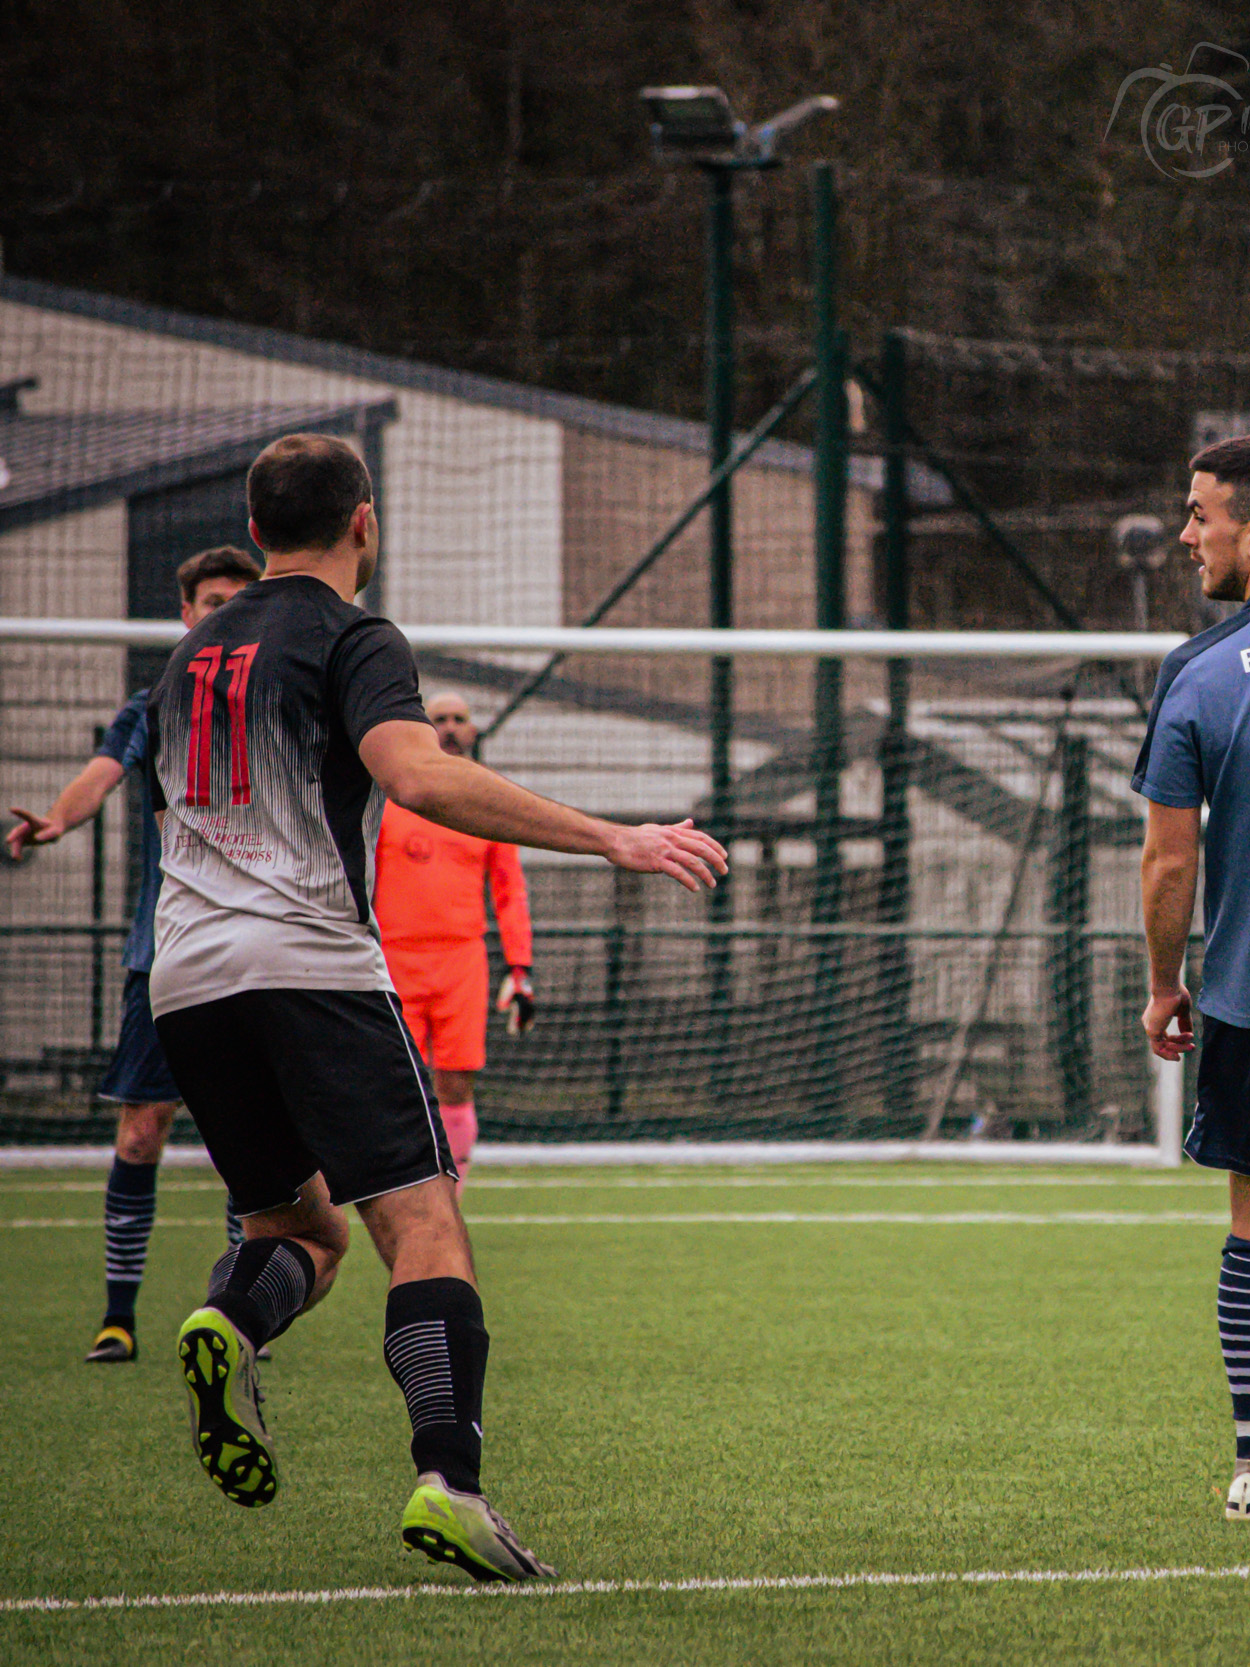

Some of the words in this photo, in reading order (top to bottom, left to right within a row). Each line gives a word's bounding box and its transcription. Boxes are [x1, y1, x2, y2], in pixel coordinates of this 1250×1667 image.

[185, 642, 260, 807] 11
[201, 816, 229, 829] THE
[215, 832, 264, 846] HOTEL
[225, 848, 273, 863] 430058
